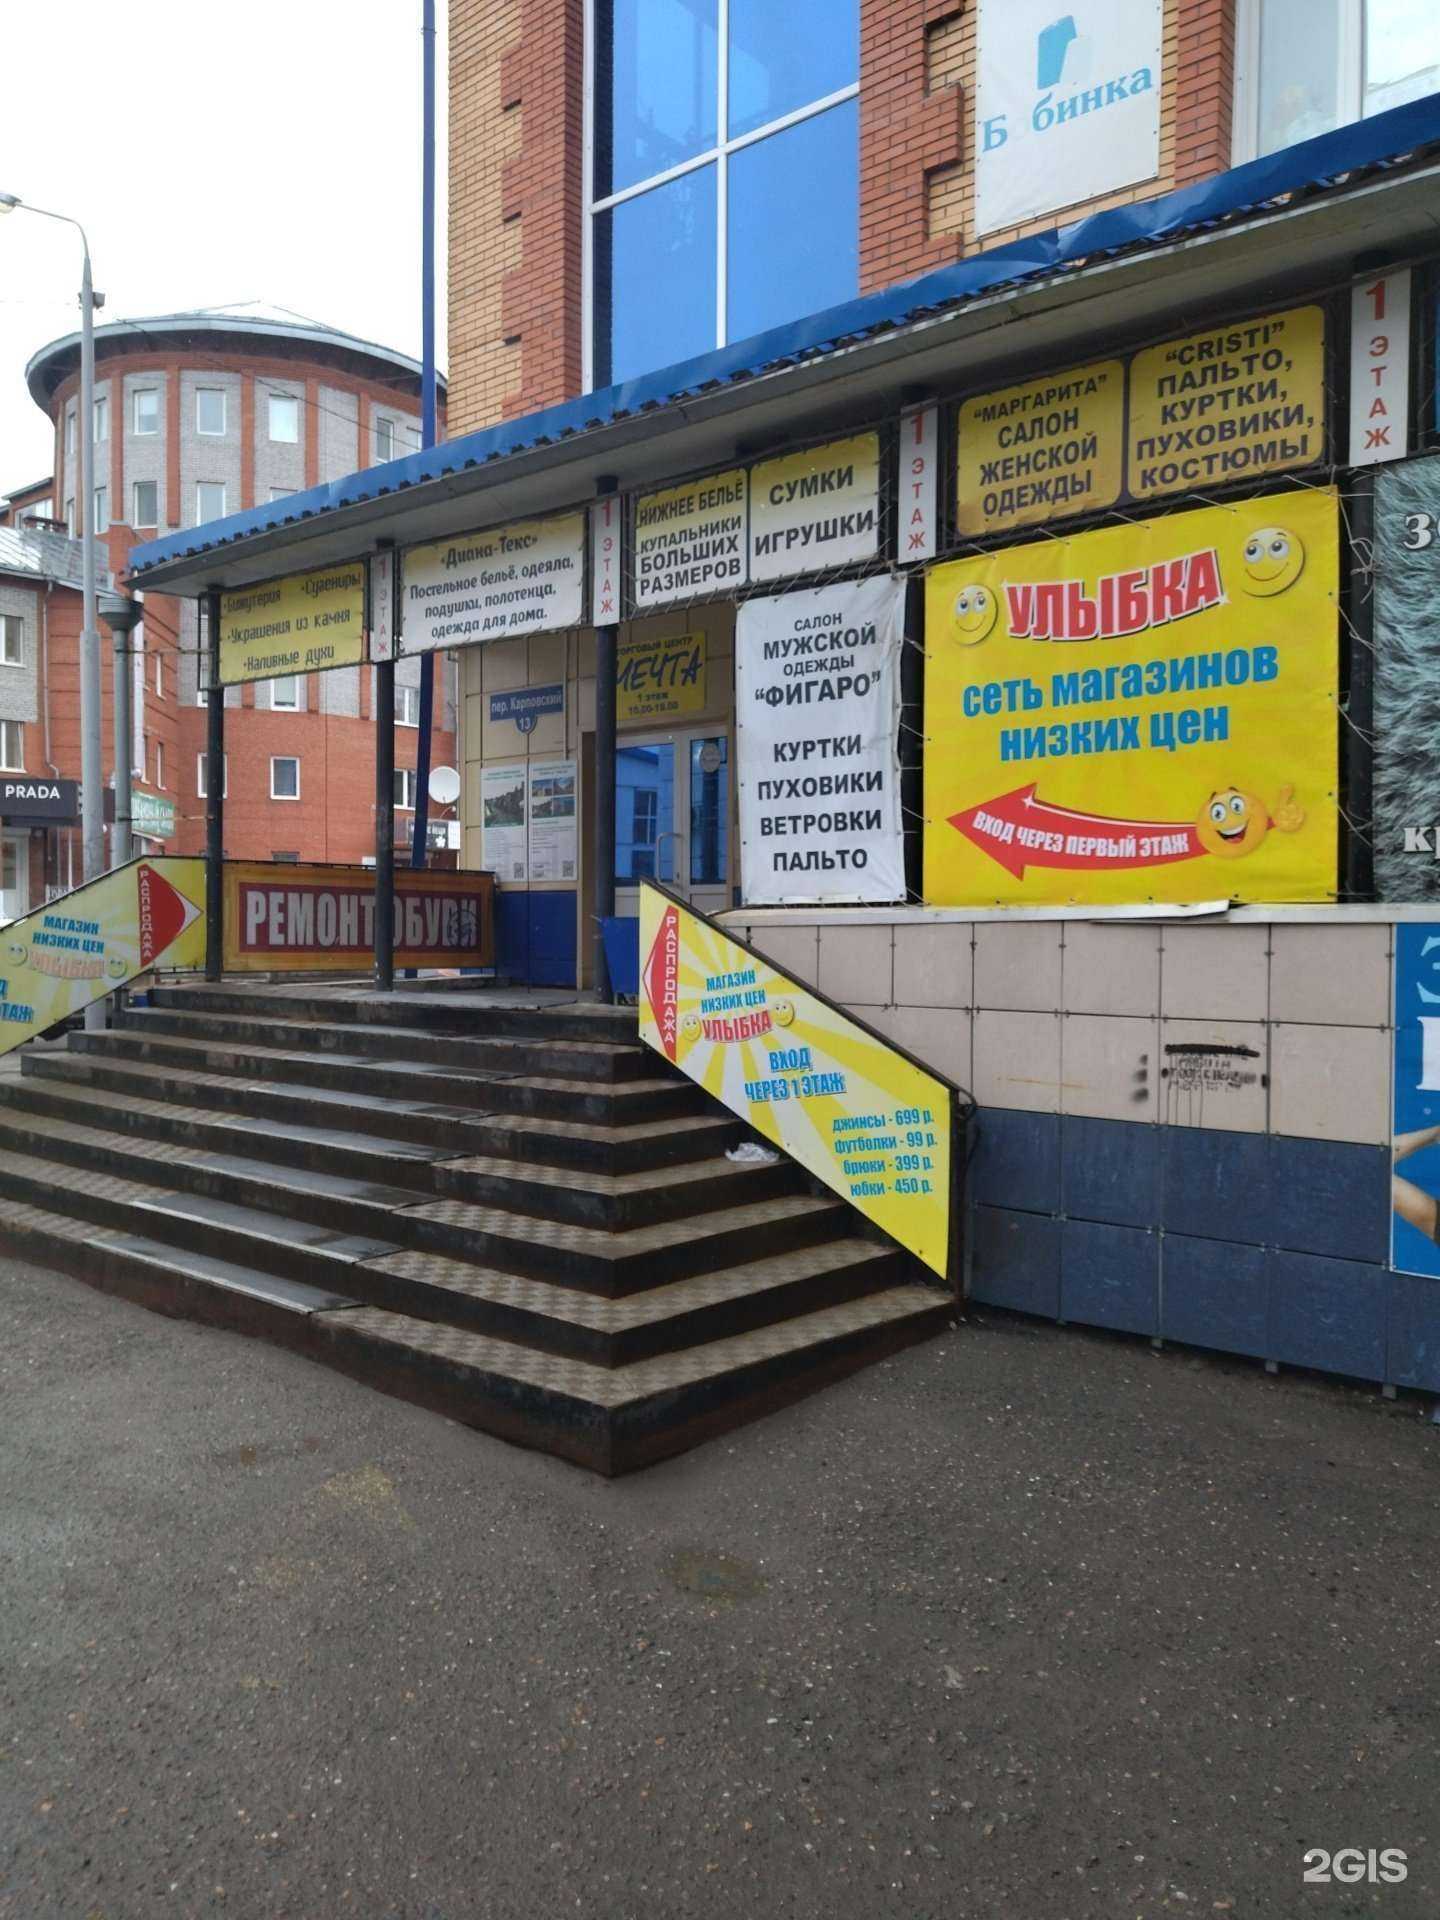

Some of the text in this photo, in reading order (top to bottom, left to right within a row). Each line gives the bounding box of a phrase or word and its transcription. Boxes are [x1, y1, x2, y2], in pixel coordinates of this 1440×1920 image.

[1157, 348, 1293, 398] ПАЛЬТО,
[1364, 280, 1391, 450] 1 ЭТАЖ
[1161, 378, 1287, 426] КУРТКИ,
[997, 406, 1080, 448] САЛОН
[1136, 403, 1315, 460] ПУХОВИКИ,
[979, 431, 1098, 486] ЖЕНСКОЙ
[1140, 434, 1308, 489] КОСТЮМЫ
[769, 465, 854, 506] СУМКИ
[907, 413, 925, 550] 1 ЭТАЖ
[982, 470, 1092, 518] ОДЕЖДЫ
[639, 478, 744, 527] НИЖНЕЕ БЕЛЬЁ
[639, 515, 742, 554] КУПАЛЬНИКИ
[754, 509, 874, 557] ИГРУШКИ
[600, 500, 614, 614] 1 ЭТАЖ
[640, 534, 739, 574] БОЛЬШИХ
[305, 573, 361, 597] Сувениры
[410, 577, 478, 600] Постельное
[480, 565, 519, 586] бельё,
[640, 558, 742, 597] РАЗМЕРОВ
[1005, 547, 1225, 641] УЛЫБКА
[231, 608, 351, 644] Украшения из камня
[425, 598, 482, 620] подушки,
[431, 620, 480, 638] одежда
[482, 613, 507, 632] для
[793, 612, 843, 632] САЛОН
[247, 645, 335, 672] Наливные духи
[763, 622, 876, 660] МУЖСКОЙ
[783, 654, 855, 677] ОДЕЖДЫ
[962, 645, 1278, 718] сеть магазинов
[754, 670, 881, 708] “ФИГАРО”
[773, 734, 861, 763] КУРТКИ
[999, 705, 1229, 761] низких цен
[5, 784, 61, 799] PRADA
[757, 771, 883, 801] ПУХОВИКИ
[760, 809, 882, 836] ВЕТРОВКИ
[972, 810, 1190, 858] ВХОД ЧЕРЕЗ ПЕРВЫЙ ЭТАЖ
[772, 848, 868, 872] ПАЛЬТО
[32, 932, 105, 955] НИЗКИХ ЦЕН
[43, 915, 100, 936] МАГАЗИН
[664, 915, 678, 1044] РАСПРОДАЖА
[706, 969, 756, 992] МАГАЗИН
[701, 989, 766, 1014] НИЗКИХ ЦЕН
[702, 1009, 773, 1042] УЛЫБКА
[769, 1047, 812, 1072] ВХОД
[745, 1072, 846, 1102] ЧЕРЕЗ 1 ЭТАЖ
[833, 1115, 886, 1134] джинсы
[895, 1108, 920, 1126] 699
[834, 1136, 898, 1154] футболки
[906, 1131, 924, 1148] 99
[843, 1159, 886, 1175] брюки
[895, 1154, 920, 1171] 399
[850, 1180, 886, 1197] юбки
[895, 1177, 919, 1194] 450
